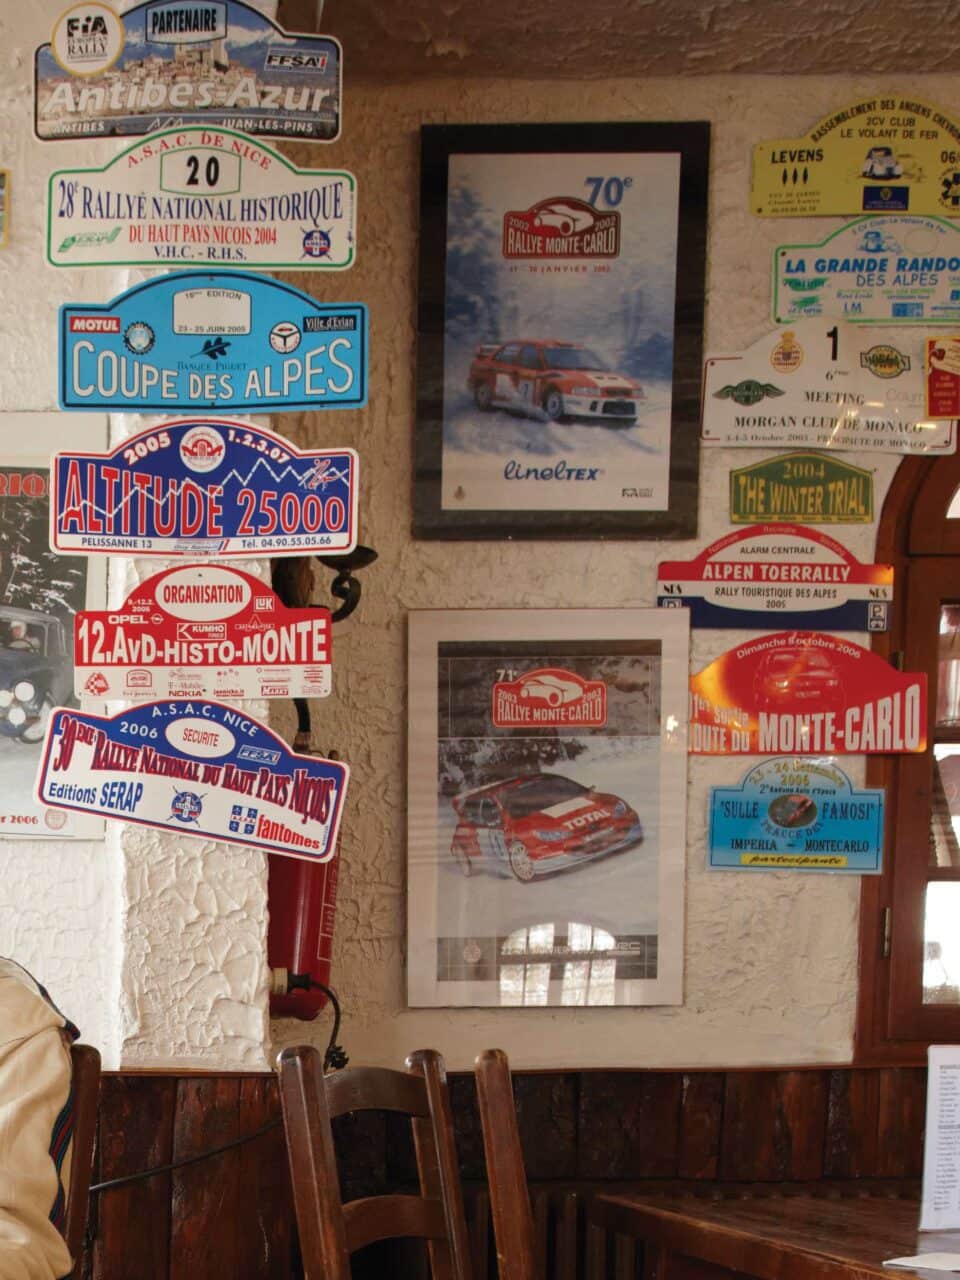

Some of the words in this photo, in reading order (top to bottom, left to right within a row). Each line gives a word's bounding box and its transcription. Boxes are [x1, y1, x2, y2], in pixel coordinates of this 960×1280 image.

[152, 9, 218, 34] PARTENAIRE
[42, 77, 331, 113] Antibes-Azur
[53, 121, 106, 134] ANTIBES
[810, 101, 877, 143] RASSEMBLEMENT
[881, 99, 896, 111] DES
[898, 100, 933, 119] ANCIENS
[866, 116, 886, 126] 2CV
[890, 116, 916, 127] CLUB
[840, 128, 853, 139] LE
[858, 128, 899, 139] VOLANT
[902, 129, 914, 140] DE
[920, 129, 939, 140] FER
[200, 131, 224, 148] DE
[231, 141, 273, 171] NICE
[771, 148, 824, 164] LEVENS
[186, 155, 220, 187] 20
[152, 199, 237, 222] NATIONAL
[240, 182, 343, 228] HISTORIQUE
[129, 226, 145, 243] DU
[148, 224, 181, 244] HAUT
[183, 226, 210, 243] PAYS
[212, 225, 252, 244] NICOIS
[255, 227, 277, 245] 2004
[507, 228, 543, 254] RALLYE
[545, 226, 617, 254] MONTE-CARLO
[785, 259, 806, 273] LA
[814, 258, 888, 273] GRANDE
[856, 274, 885, 287] DES
[892, 273, 938, 287] ALPES
[206, 290, 242, 301] EDITION
[72, 319, 119, 332] MOTUL
[207, 325, 225, 333] JUIN
[826, 326, 839, 361] 1
[73, 340, 179, 398] COUPE
[189, 374, 233, 400] DES
[244, 338, 354, 398] ALPES
[804, 390, 865, 406] MEETING
[734, 416, 797, 428] MORGAN
[843, 418, 860, 431] DE
[864, 419, 923, 434] MONACO
[123, 432, 172, 467] 2005
[783, 463, 825, 479] 2004
[61, 459, 224, 537] ALTITUDE
[236, 488, 346, 536] 25000
[738, 475, 765, 513] THE
[770, 480, 824, 514] WINTER
[828, 477, 865, 515] TRIAL
[81, 536, 139, 549] PELISSANNE
[141, 539, 152, 549] 13
[740, 547, 769, 555] ALARM
[771, 547, 816, 555] CENTRALE
[702, 564, 754, 580] ALPEN
[760, 564, 851, 582] TOERRALLY
[163, 584, 244, 604] ORGANISATION
[715, 586, 738, 596] RALLY
[742, 587, 793, 598] TOURISTIQUE
[795, 588, 812, 598] DES
[814, 588, 837, 599] ALPES
[107, 615, 149, 625] OPEL
[192, 625, 225, 633] KUMHO
[737, 637, 786, 660] Dimanche
[796, 637, 836, 649] octobre
[836, 643, 861, 659] 2006
[497, 697, 531, 721] RALLYE
[533, 698, 602, 721] MONTE-CARLO
[758, 683, 921, 752] MONTE-CARLO
[120, 721, 159, 739] 2006
[224, 711, 259, 738] NICE
[182, 727, 220, 748] SECURITE
[90, 729, 140, 773] RALLYE
[139, 745, 201, 783] NATIONAL
[201, 764, 223, 786] DU
[221, 762, 259, 797] HAUT
[255, 766, 291, 808] PAYS
[48, 781, 98, 805] Editions
[100, 781, 144, 813] SERAP
[10, 815, 39, 825] 2006
[562, 809, 611, 831] TOTAL
[256, 813, 321, 850] fantomes
[730, 838, 778, 851] IMPERIA
[804, 839, 870, 853] MONTECARLO
